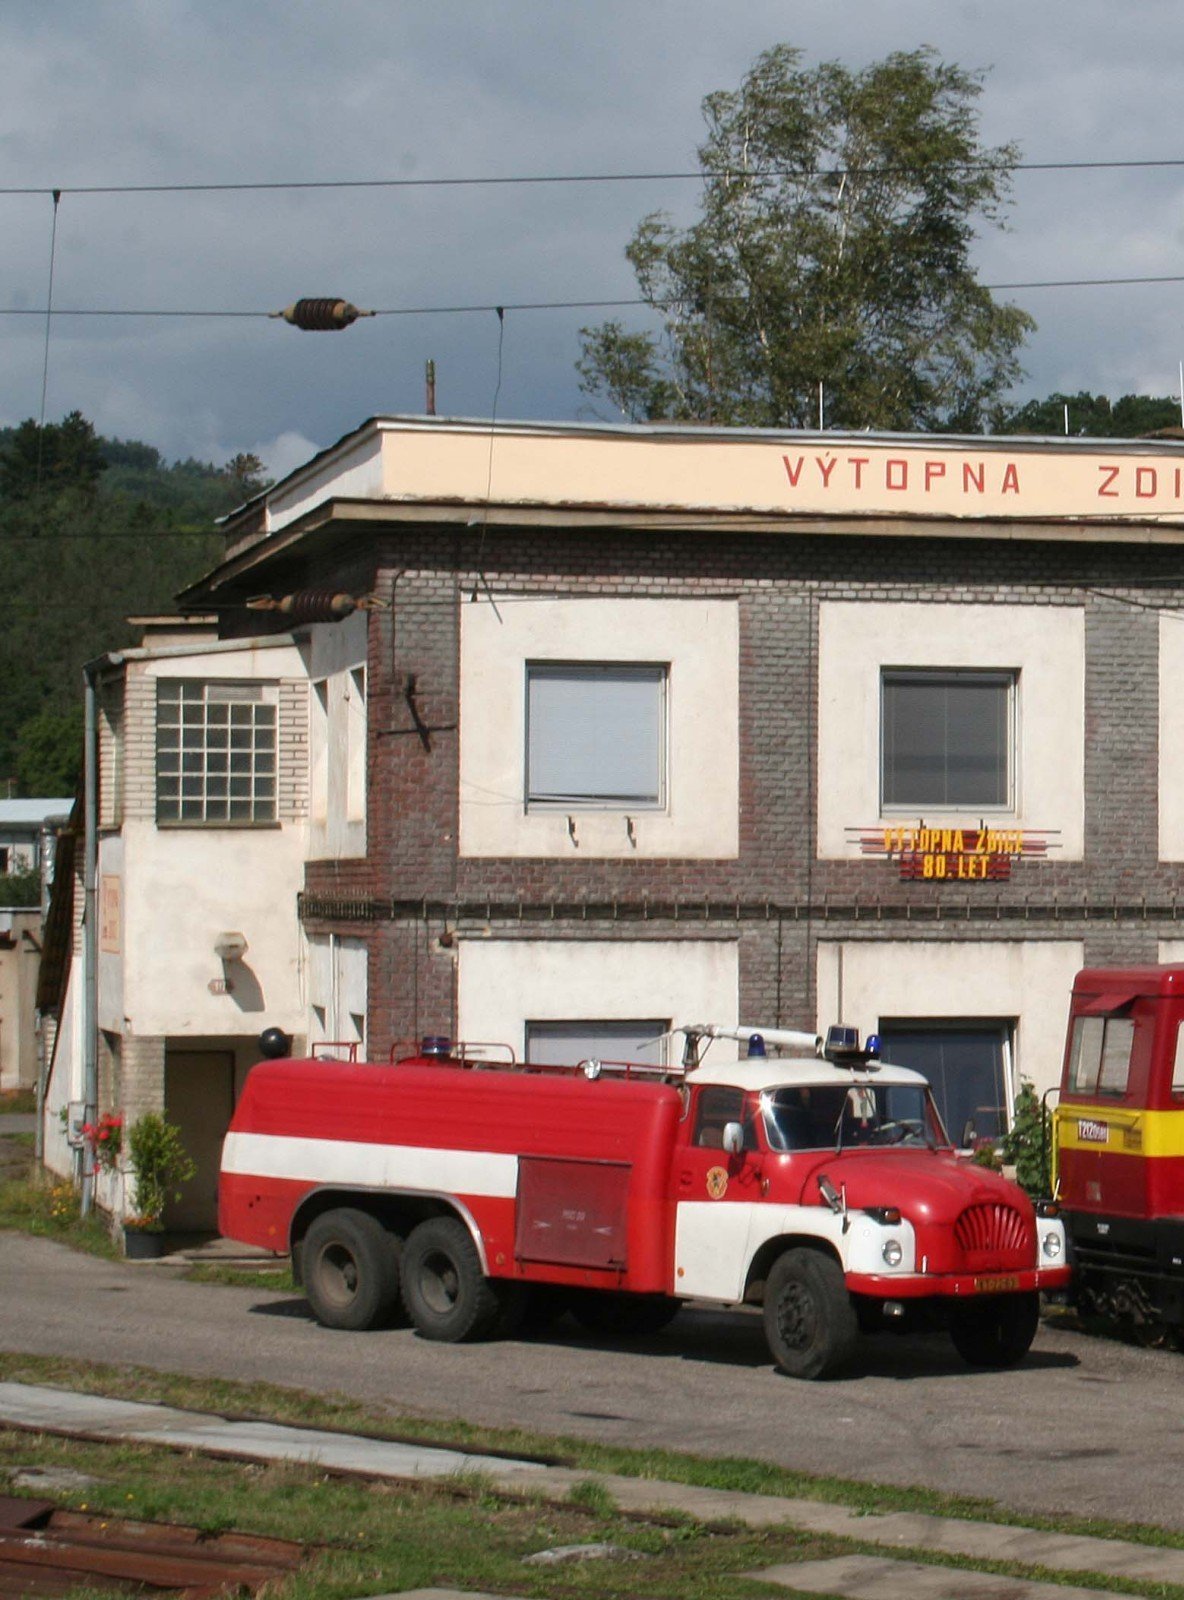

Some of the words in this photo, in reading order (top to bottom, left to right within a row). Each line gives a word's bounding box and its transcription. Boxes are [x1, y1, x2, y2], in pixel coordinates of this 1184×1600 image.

[781, 451, 1020, 494] VÝTOPNA
[976, 829, 1024, 854] ZDICE
[958, 855, 990, 878] LET
